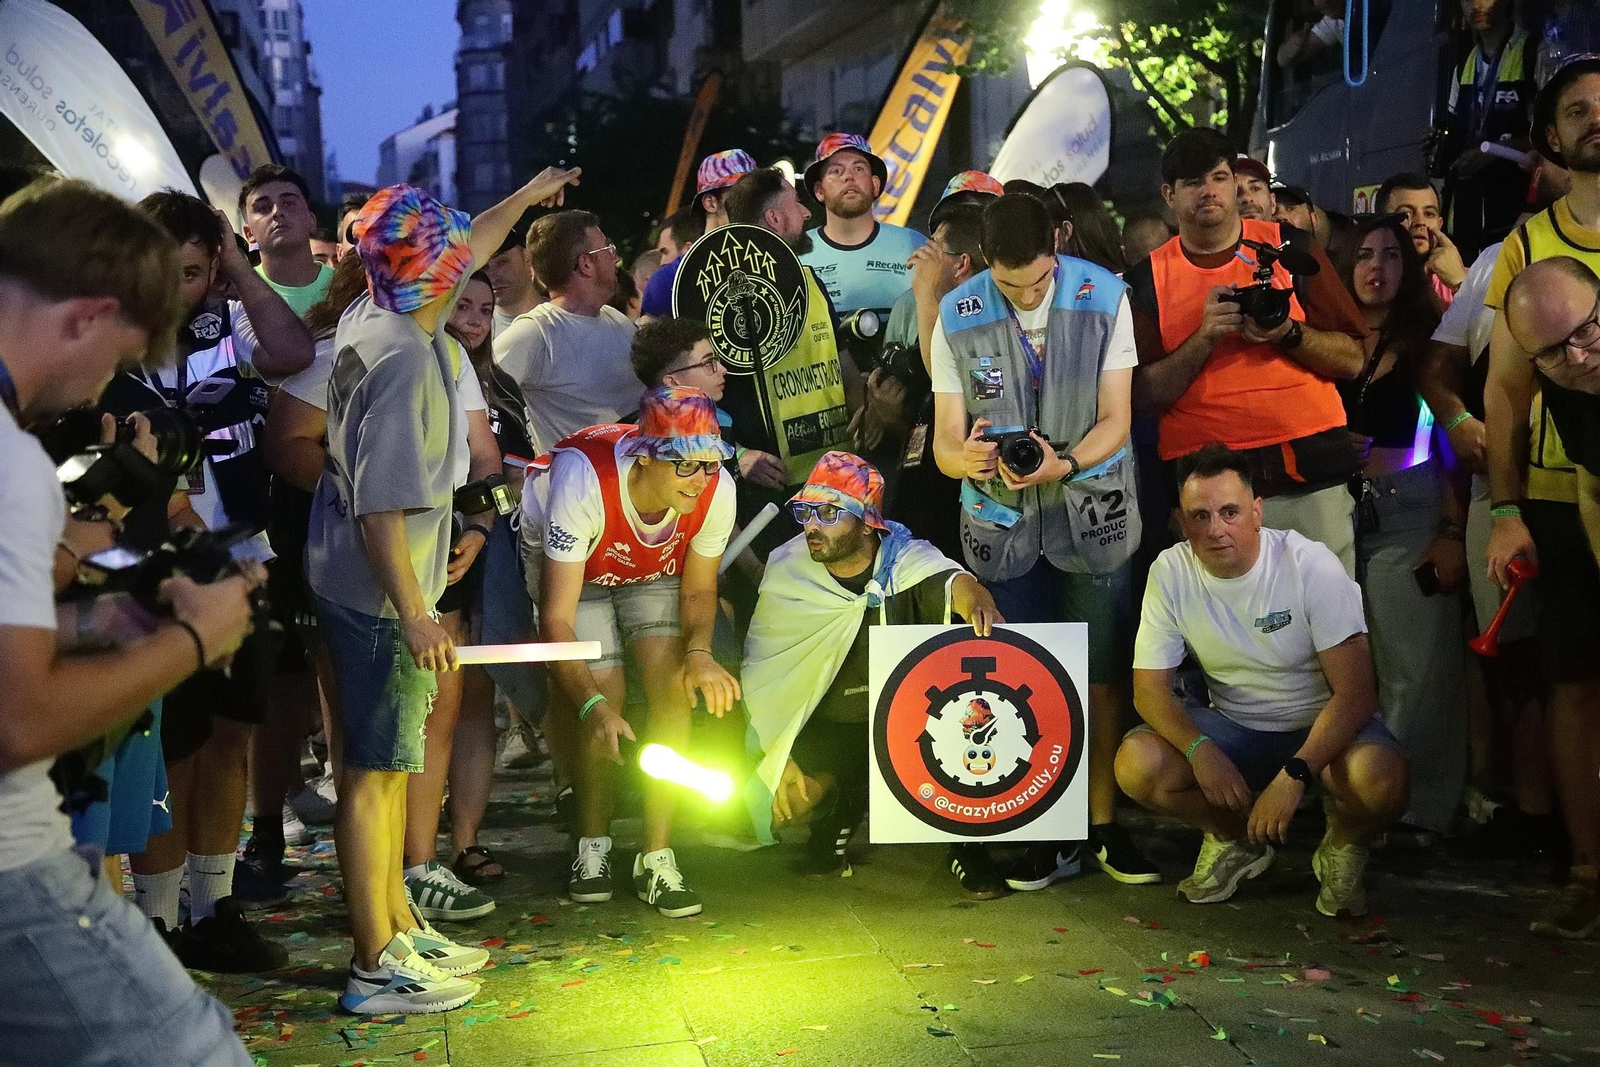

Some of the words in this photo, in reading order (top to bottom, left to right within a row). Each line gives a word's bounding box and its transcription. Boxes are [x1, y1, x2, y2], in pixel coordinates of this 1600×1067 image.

[875, 260, 907, 271] Recalvi
[711, 299, 724, 337] CRAZY
[1079, 489, 1127, 527] 12
[1080, 518, 1128, 541] PRODUC
[934, 743, 1064, 819] @crazyfansrally_ou
